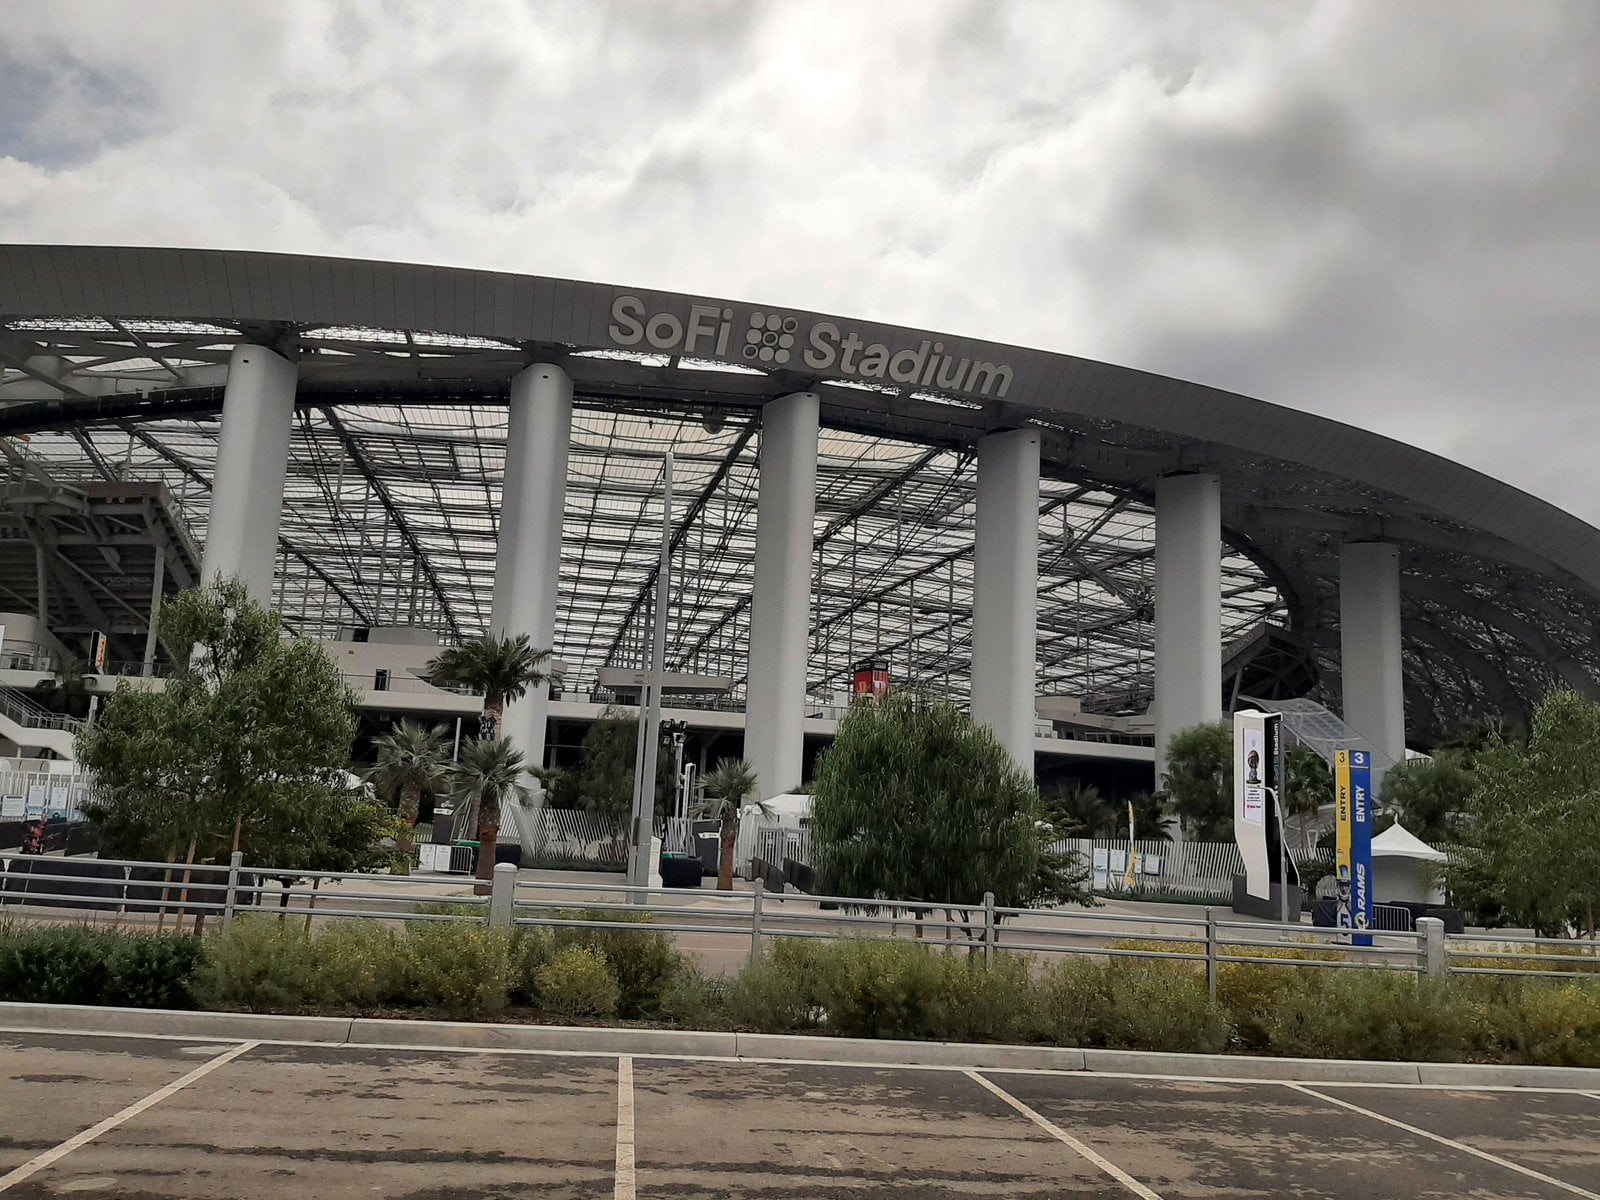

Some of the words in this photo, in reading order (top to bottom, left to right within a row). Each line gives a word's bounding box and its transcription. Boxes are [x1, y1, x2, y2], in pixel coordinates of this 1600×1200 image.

[608, 295, 733, 356] SoFi
[803, 321, 1014, 397] Stadium
[1339, 752, 1346, 763] 3
[1354, 752, 1364, 764] 3
[1355, 785, 1366, 823] ENTRY
[1356, 862, 1366, 911] RAMS
